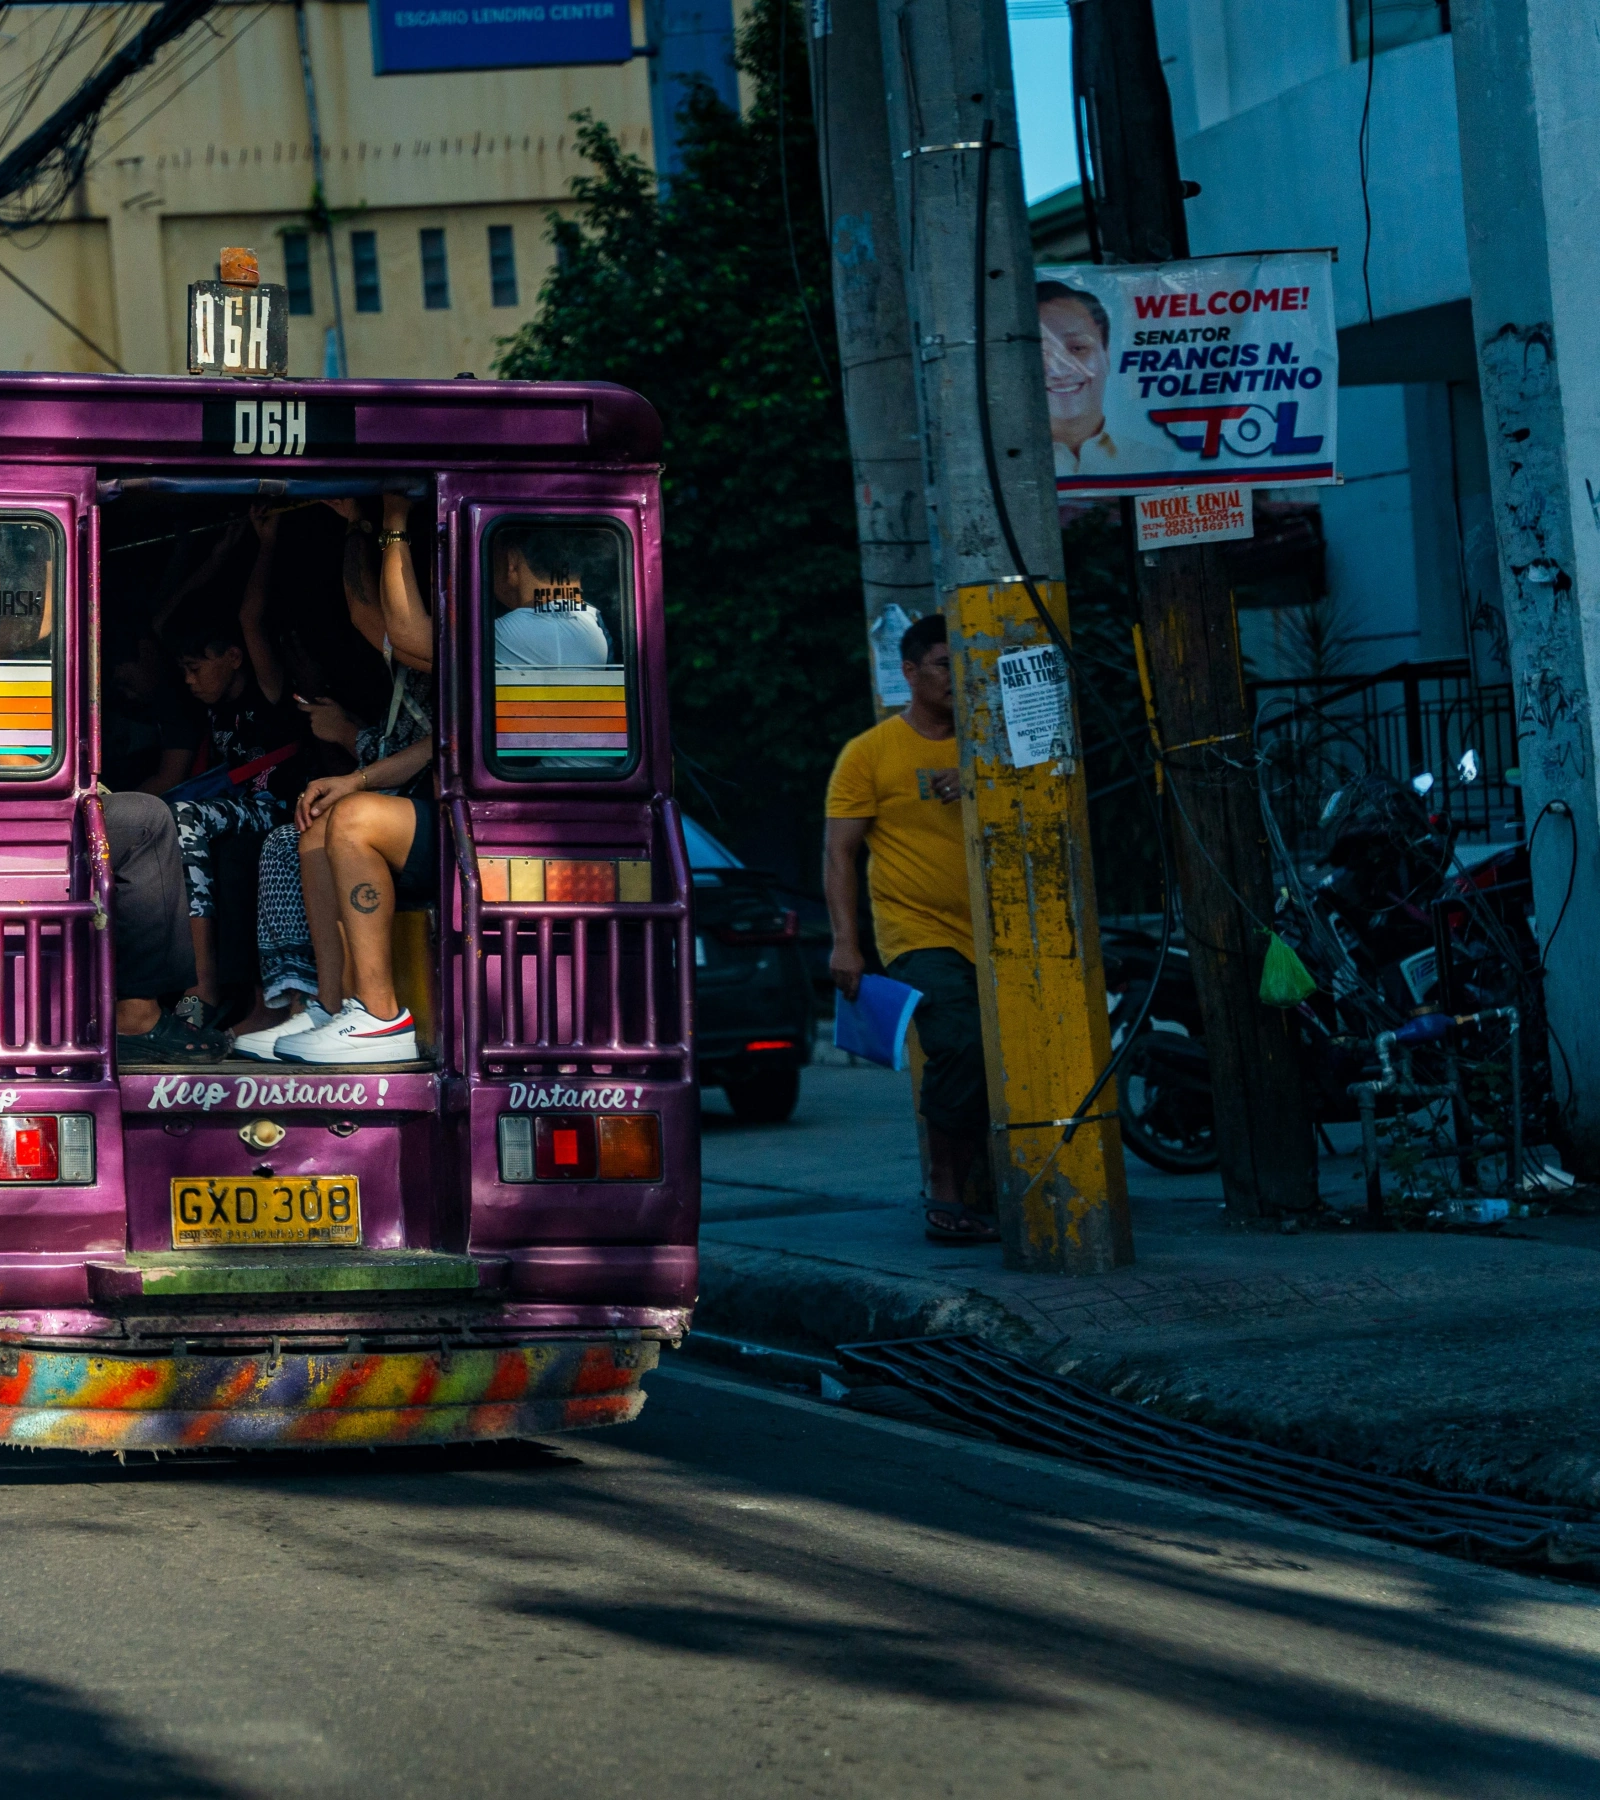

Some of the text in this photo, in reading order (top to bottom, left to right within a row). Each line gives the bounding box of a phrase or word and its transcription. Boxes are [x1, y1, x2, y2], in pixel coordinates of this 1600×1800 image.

[471, 7, 546, 25] LENDING
[549, 2, 615, 20] CENTER
[1134, 286, 1310, 320] WELCOME!
[1133, 326, 1231, 346] SENATOR
[1118, 341, 1300, 374] FRANCIS N.
[1137, 366, 1323, 399] TOLENTINO
[1147, 401, 1324, 460] TOL
[1197, 489, 1243, 515] RENTAL
[338, 1025, 356, 1036] FILA
[147, 1076, 230, 1111] Keep
[179, 1185, 350, 1224] GXD 308
